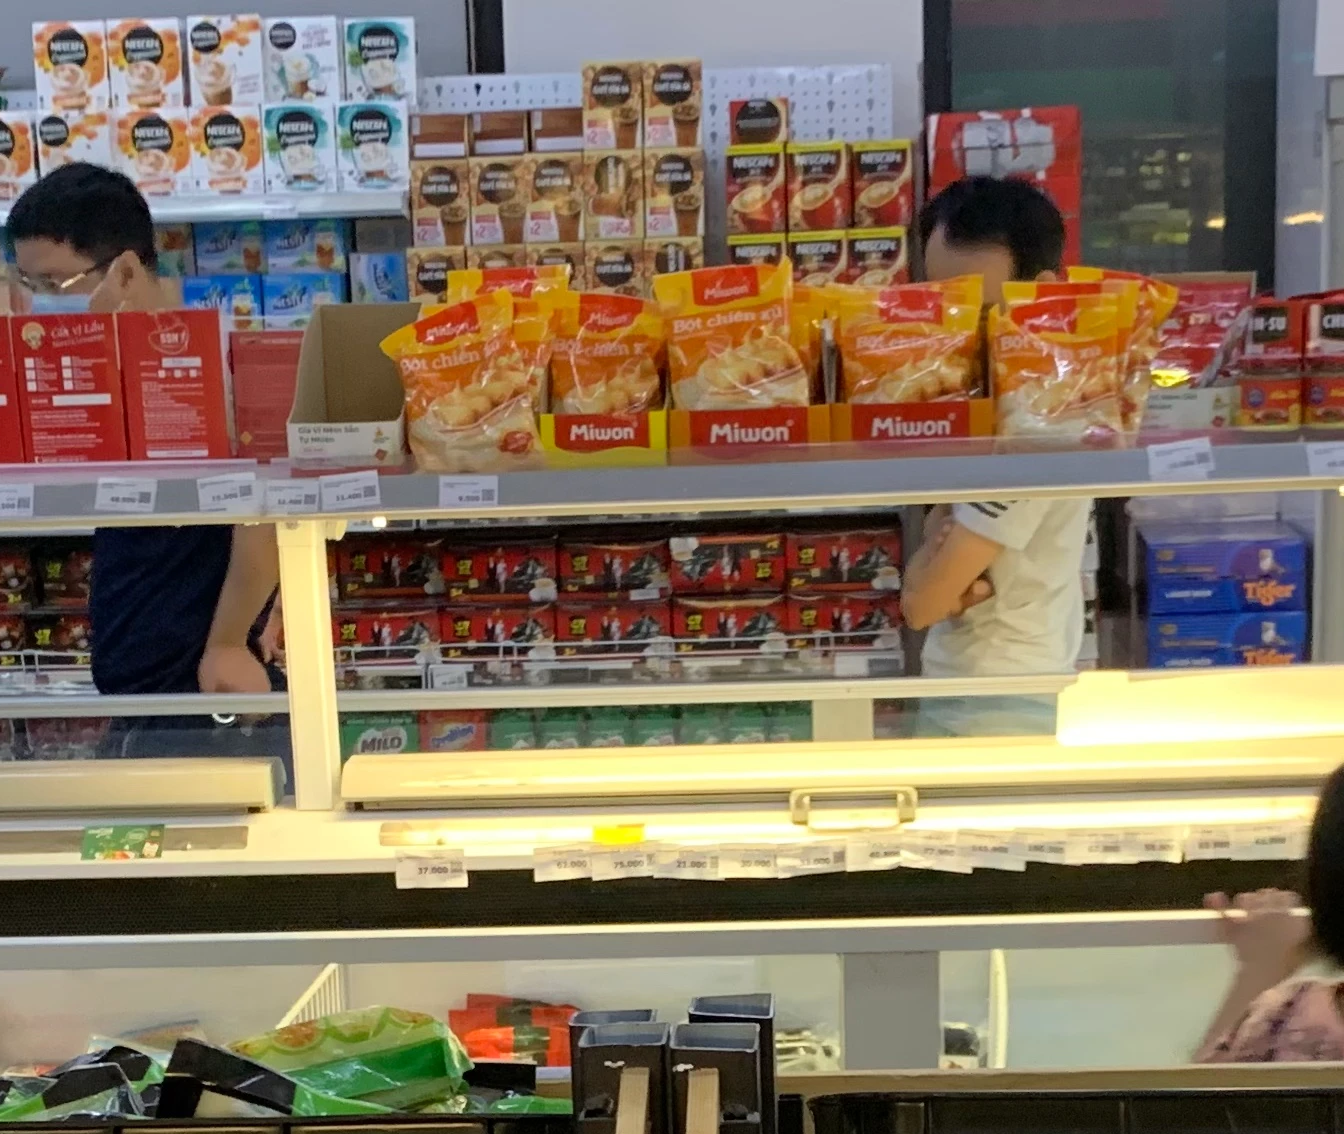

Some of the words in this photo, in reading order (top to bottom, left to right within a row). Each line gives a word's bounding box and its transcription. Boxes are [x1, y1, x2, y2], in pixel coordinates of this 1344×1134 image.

[570, 424, 634, 441] Miwon
[710, 423, 789, 443] Miwon
[872, 417, 951, 438] Miwon
[1243, 580, 1296, 606] Tiger
[360, 735, 403, 753] MILO
